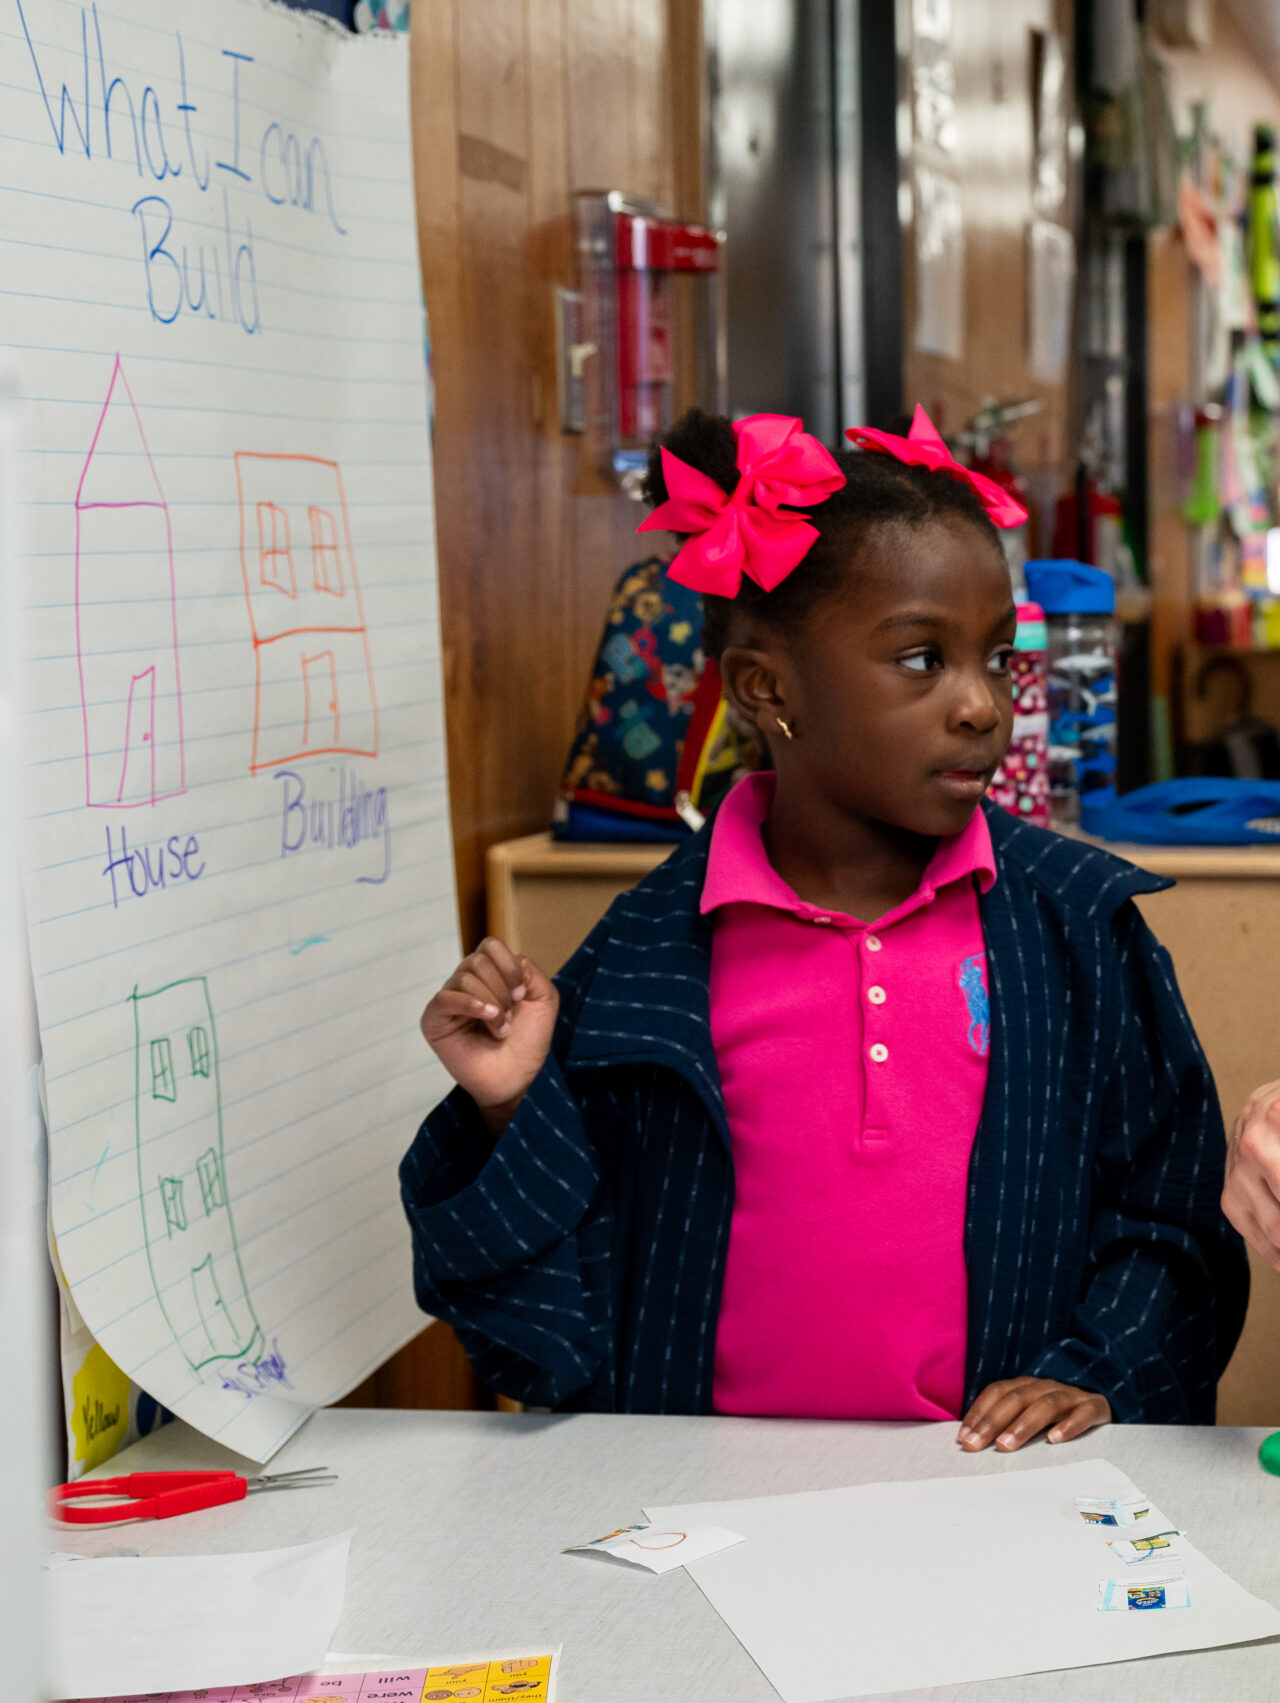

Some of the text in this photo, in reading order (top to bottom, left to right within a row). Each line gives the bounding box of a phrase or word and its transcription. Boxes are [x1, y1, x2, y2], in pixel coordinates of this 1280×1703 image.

[17, 0, 347, 236] What I can
[131, 187, 262, 335] Build
[273, 763, 392, 885] Building
[102, 825, 205, 909] House
[82, 1396, 120, 1444] Yellow
[367, 1691, 413, 1699] were
[378, 1675, 411, 1684] will
